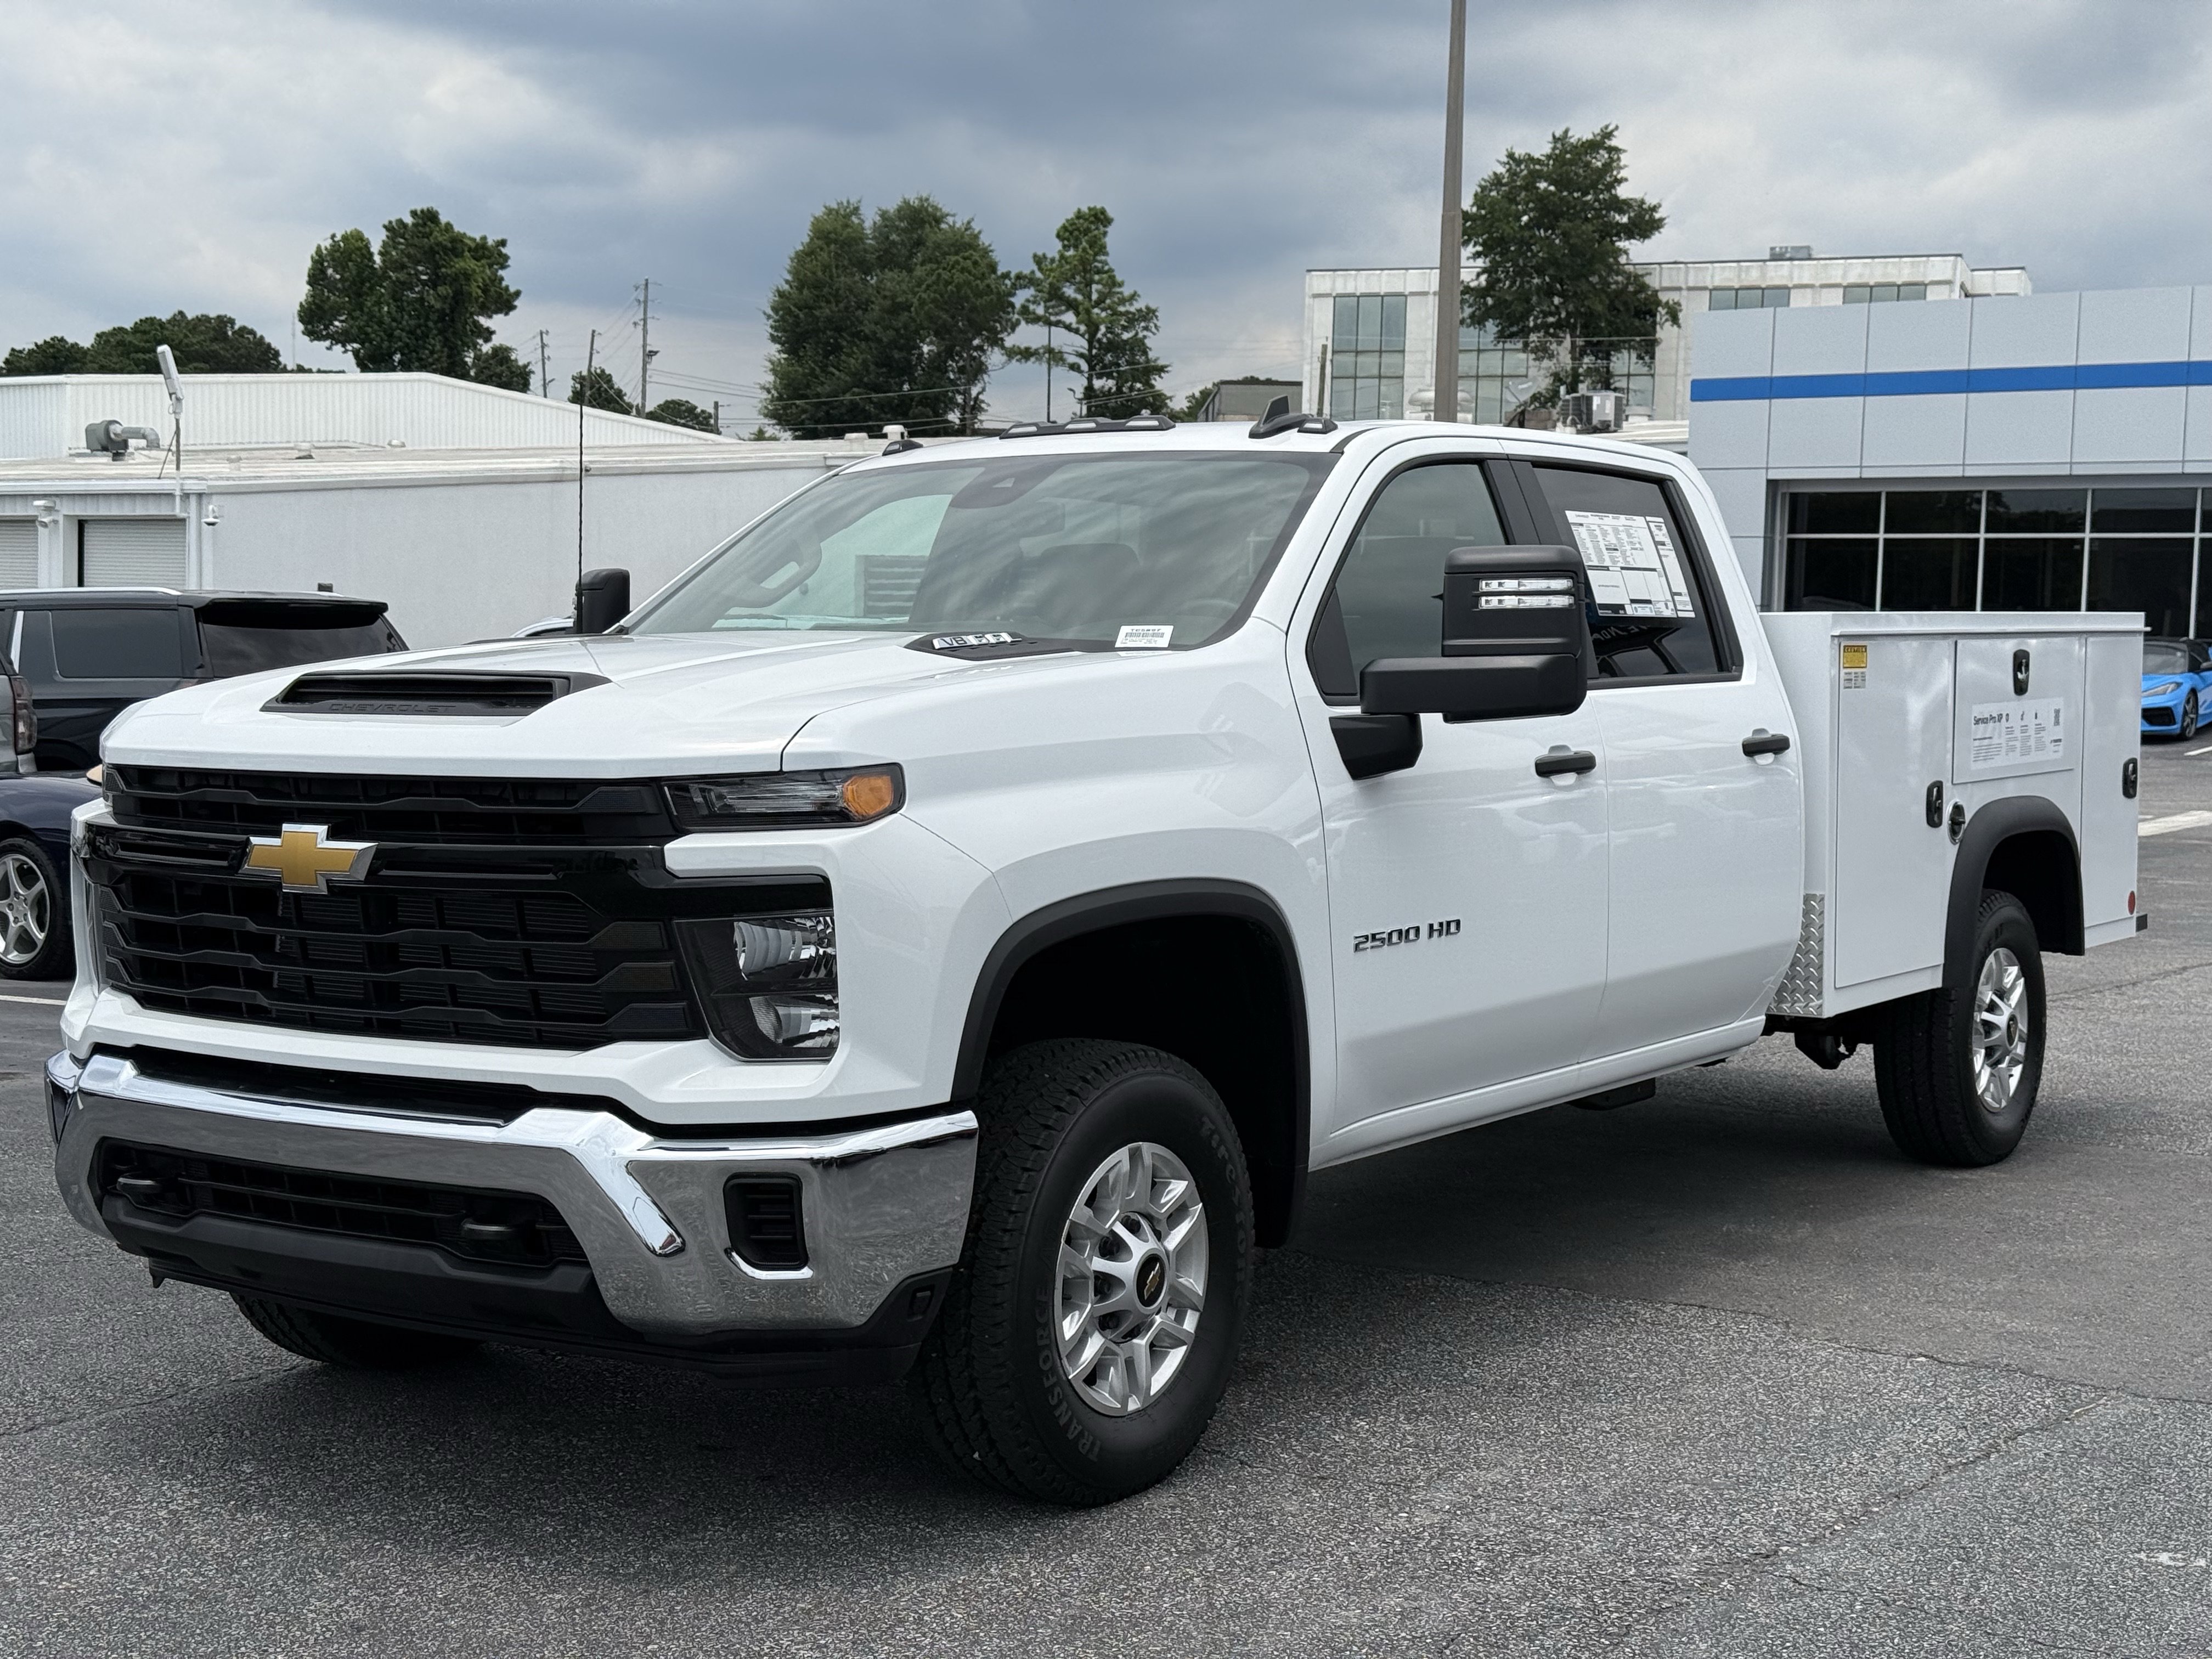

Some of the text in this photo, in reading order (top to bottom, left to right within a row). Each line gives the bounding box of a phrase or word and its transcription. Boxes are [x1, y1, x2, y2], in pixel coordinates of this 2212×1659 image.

[940, 636, 968, 645] V8
[330, 703, 456, 712] CHEVROLET
[1973, 715, 1989, 725] Service
[1997, 713, 2003, 723] XP
[1353, 918, 1462, 953] 2500 HD
[1035, 1286, 1103, 1462] TRANSFORCE
